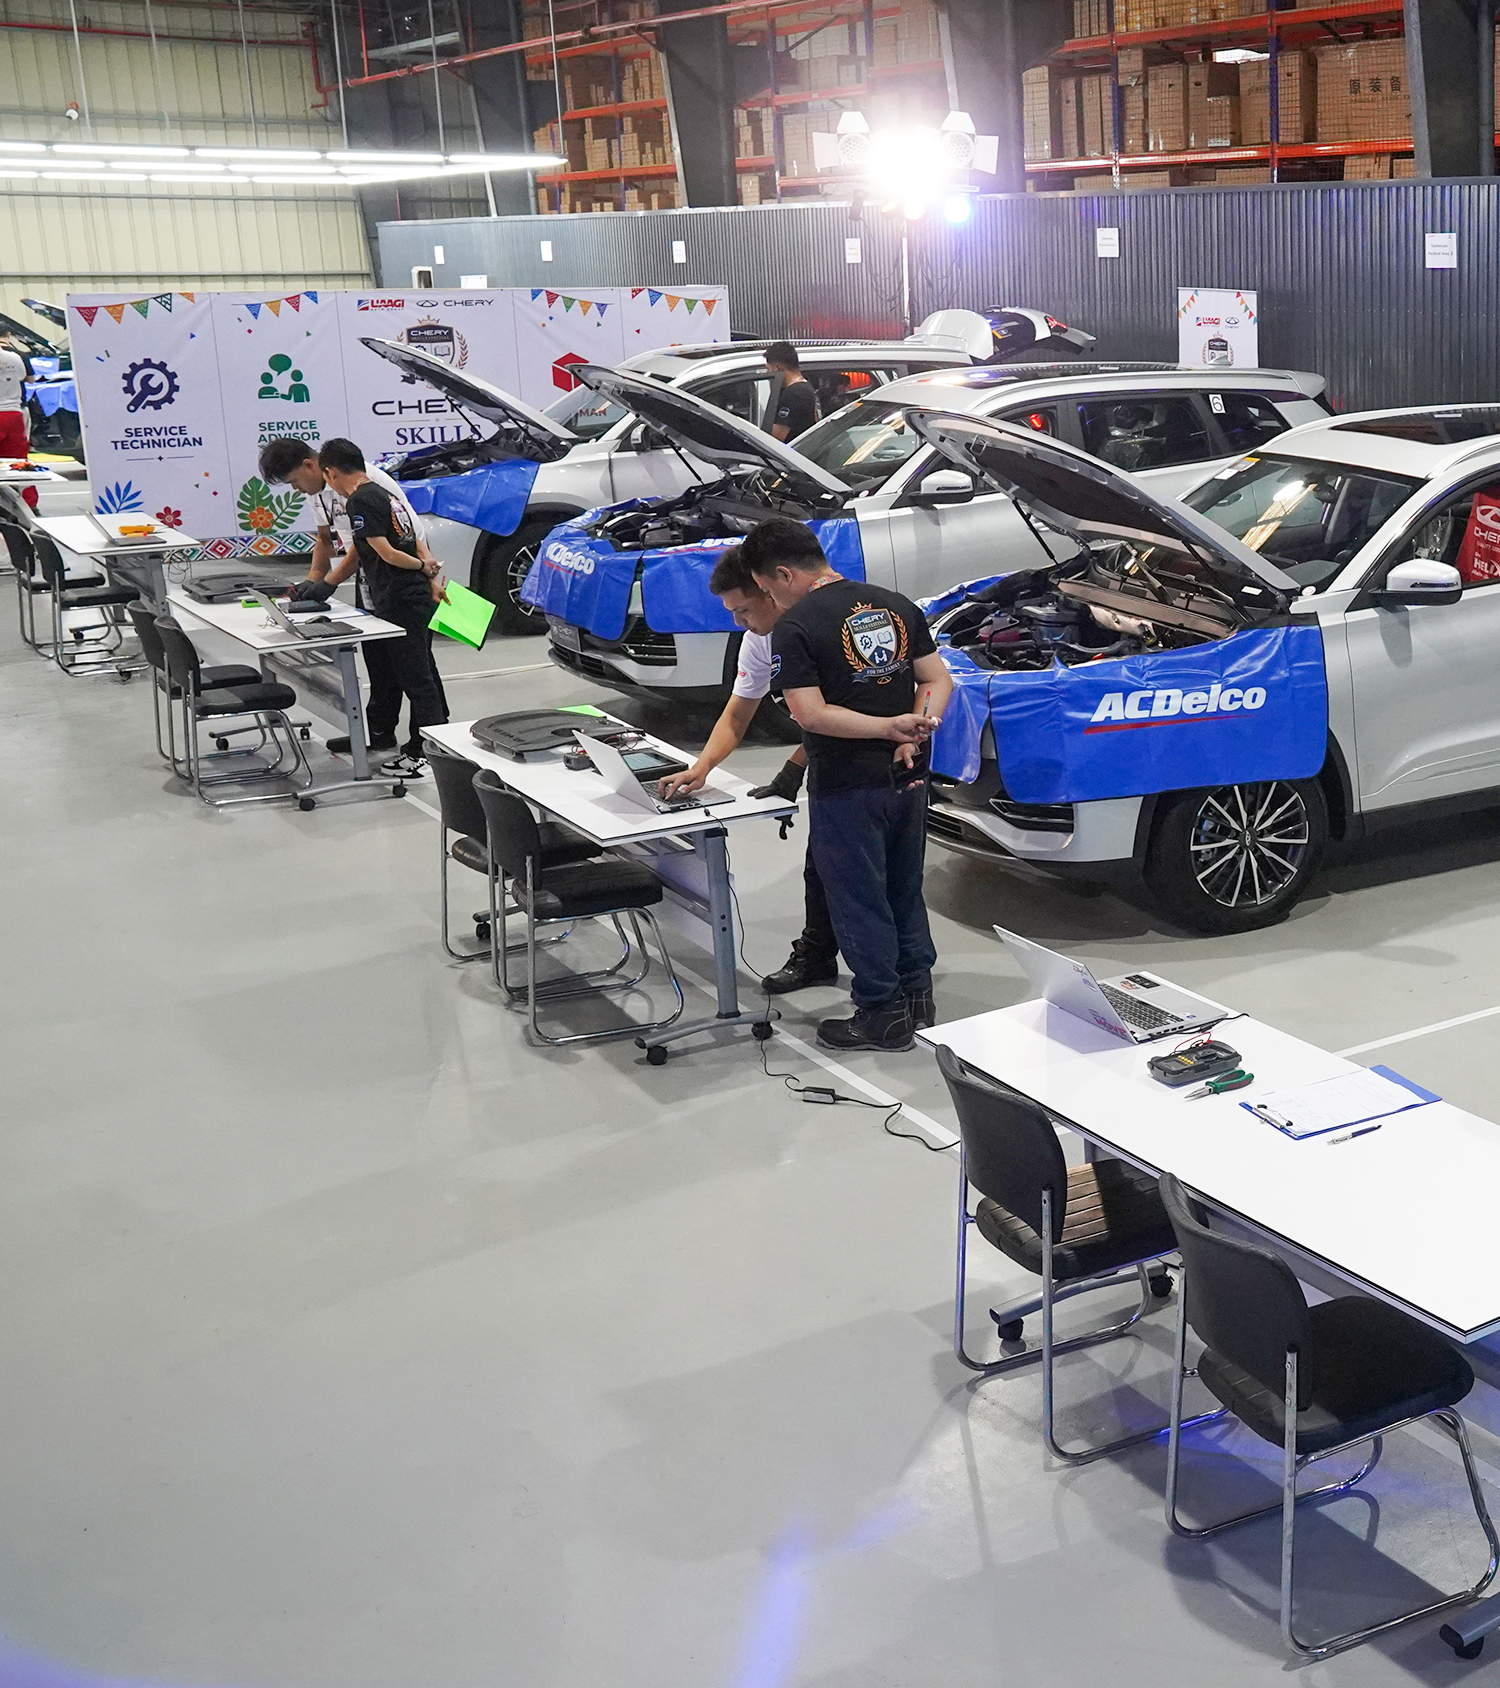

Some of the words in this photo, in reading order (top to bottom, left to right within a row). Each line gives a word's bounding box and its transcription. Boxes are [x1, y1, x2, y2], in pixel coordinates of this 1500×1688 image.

[443, 299, 494, 307] CHERY
[372, 399, 461, 415] CHE
[1211, 396, 1223, 412] 6
[124, 426, 188, 438] SERVICE
[258, 420, 317, 432] SERVICE
[111, 436, 203, 450] TECHNICIAN
[851, 612, 885, 626] CHERY
[1090, 684, 1266, 722] ACDelco
